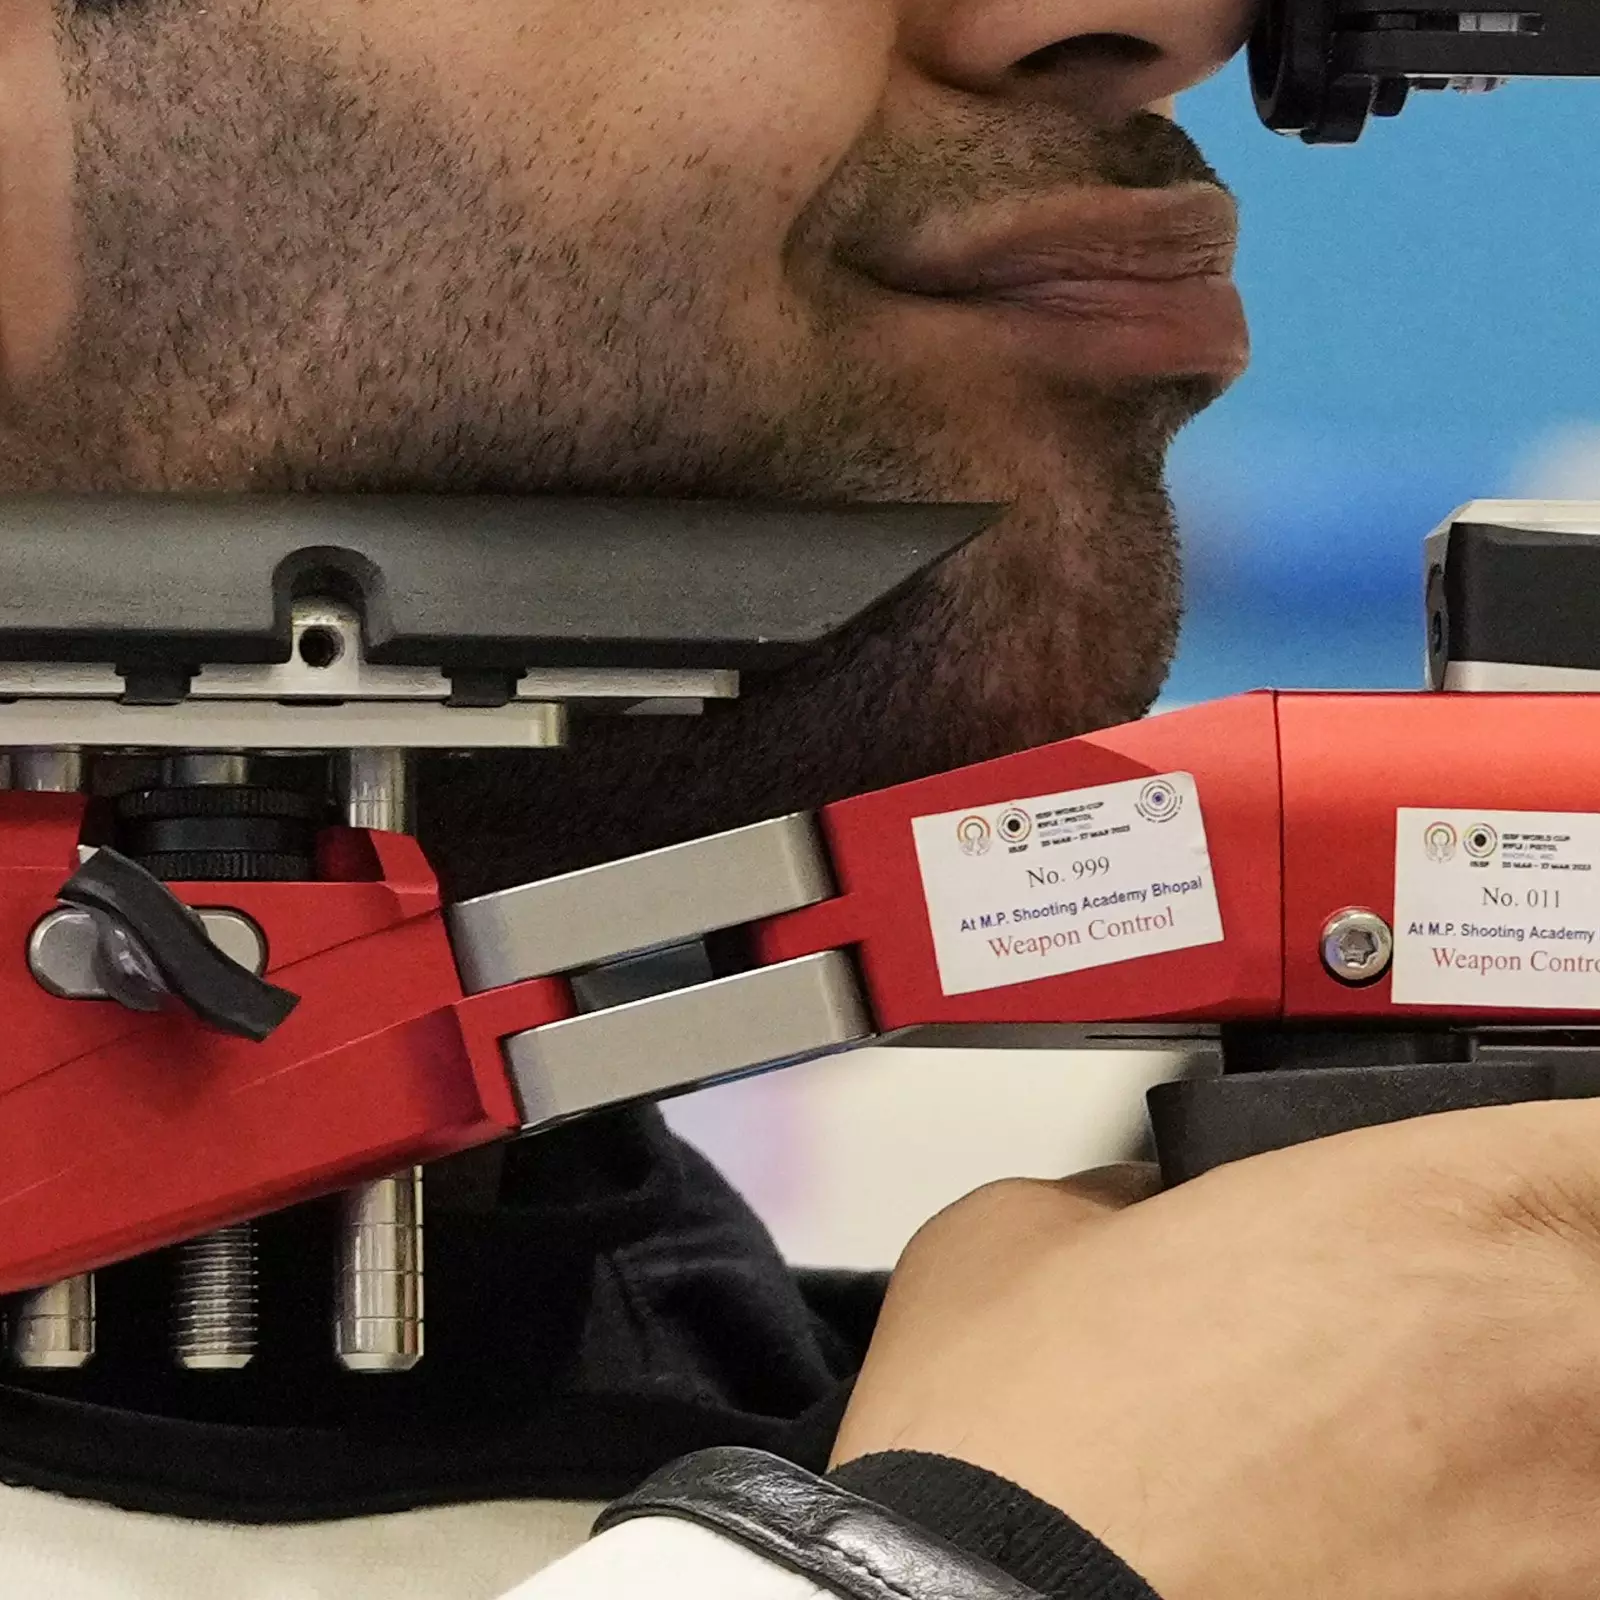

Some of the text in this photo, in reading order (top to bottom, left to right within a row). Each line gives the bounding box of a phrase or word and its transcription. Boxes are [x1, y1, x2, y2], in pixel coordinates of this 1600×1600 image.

[1025, 856, 1110, 888] No. 999
[960, 876, 1202, 933] At M.P. Shooting Academy Bhopal
[1481, 887, 1560, 908] No. 011
[987, 906, 1175, 958] Weapon Control
[1408, 922, 1424, 936] At
[1428, 923, 1456, 937] M.P.
[1461, 924, 1525, 942] Shooting
[1530, 926, 1595, 944] Academy
[1432, 948, 1521, 976] Weapon
